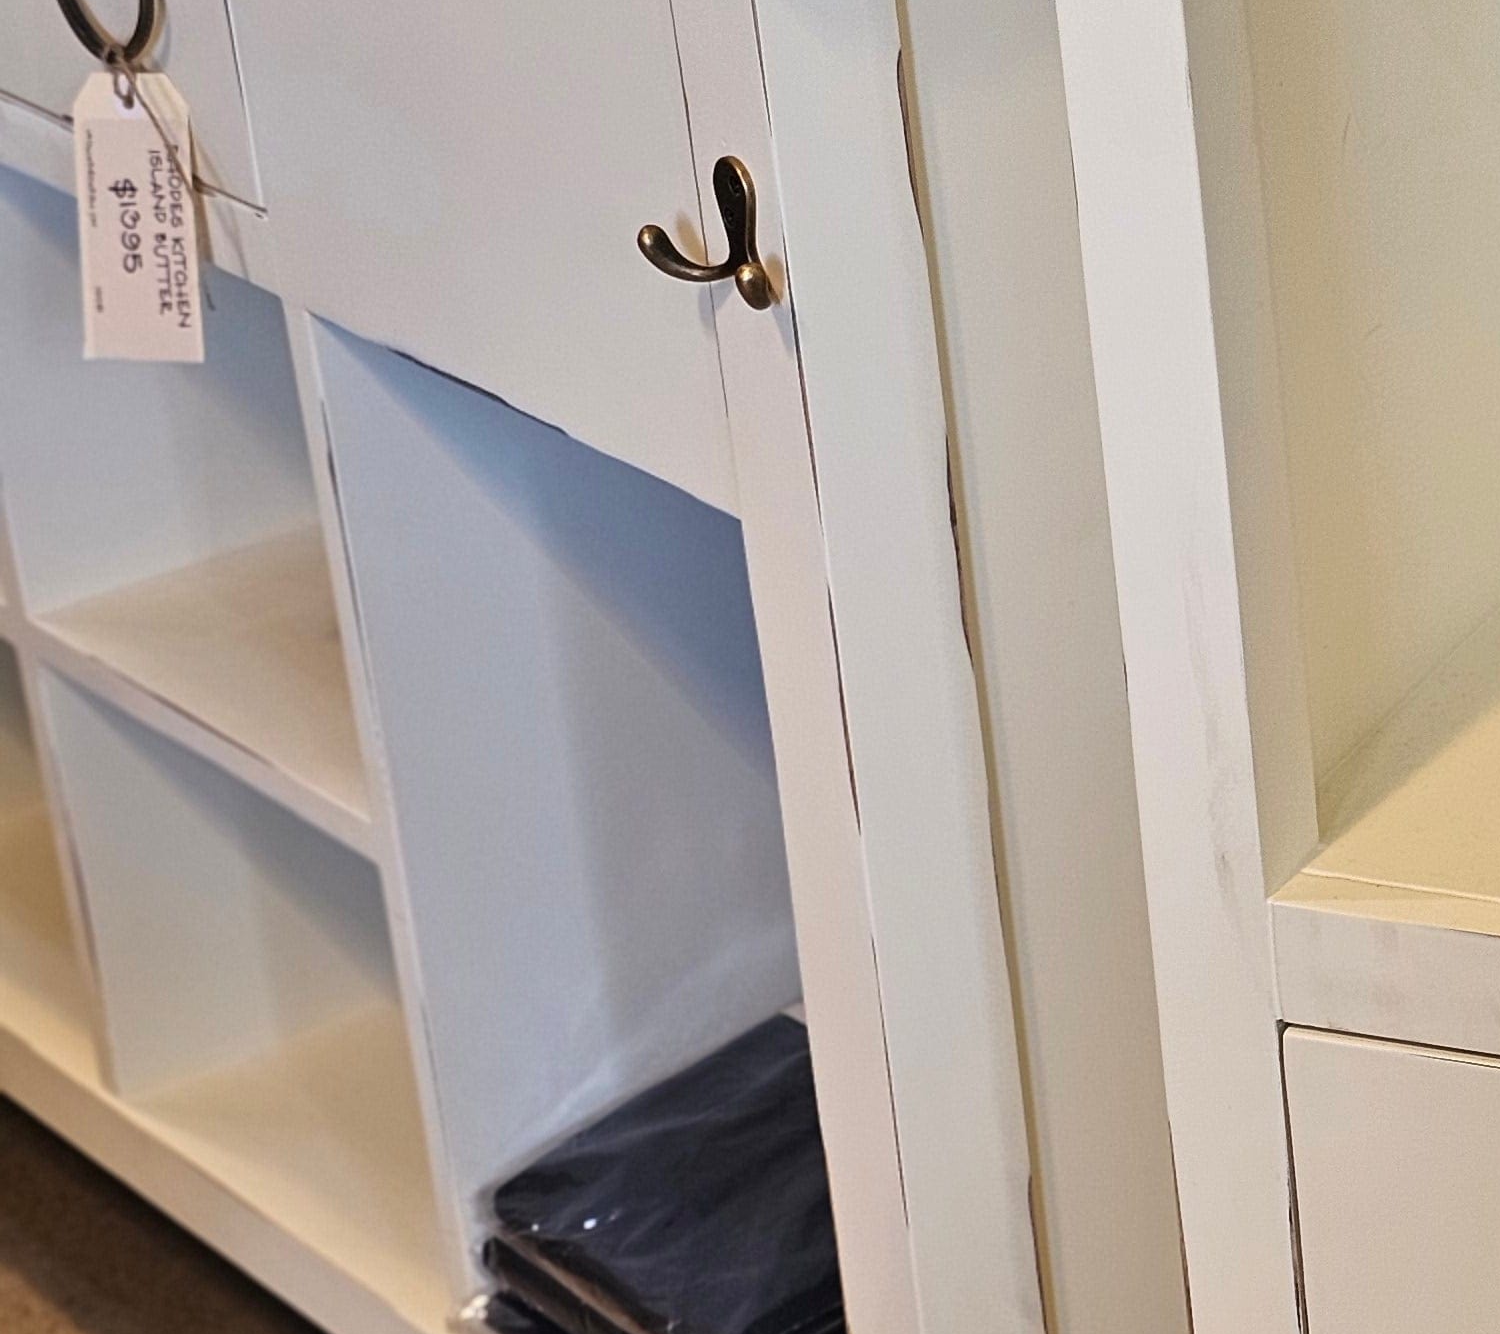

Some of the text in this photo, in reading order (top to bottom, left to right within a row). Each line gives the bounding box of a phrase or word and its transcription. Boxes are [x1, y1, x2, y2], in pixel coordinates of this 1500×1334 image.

[108, 178, 144, 274] $1395
[147, 150, 173, 315] ISLAND BUTTER
[171, 236, 193, 329] KITCHEN
